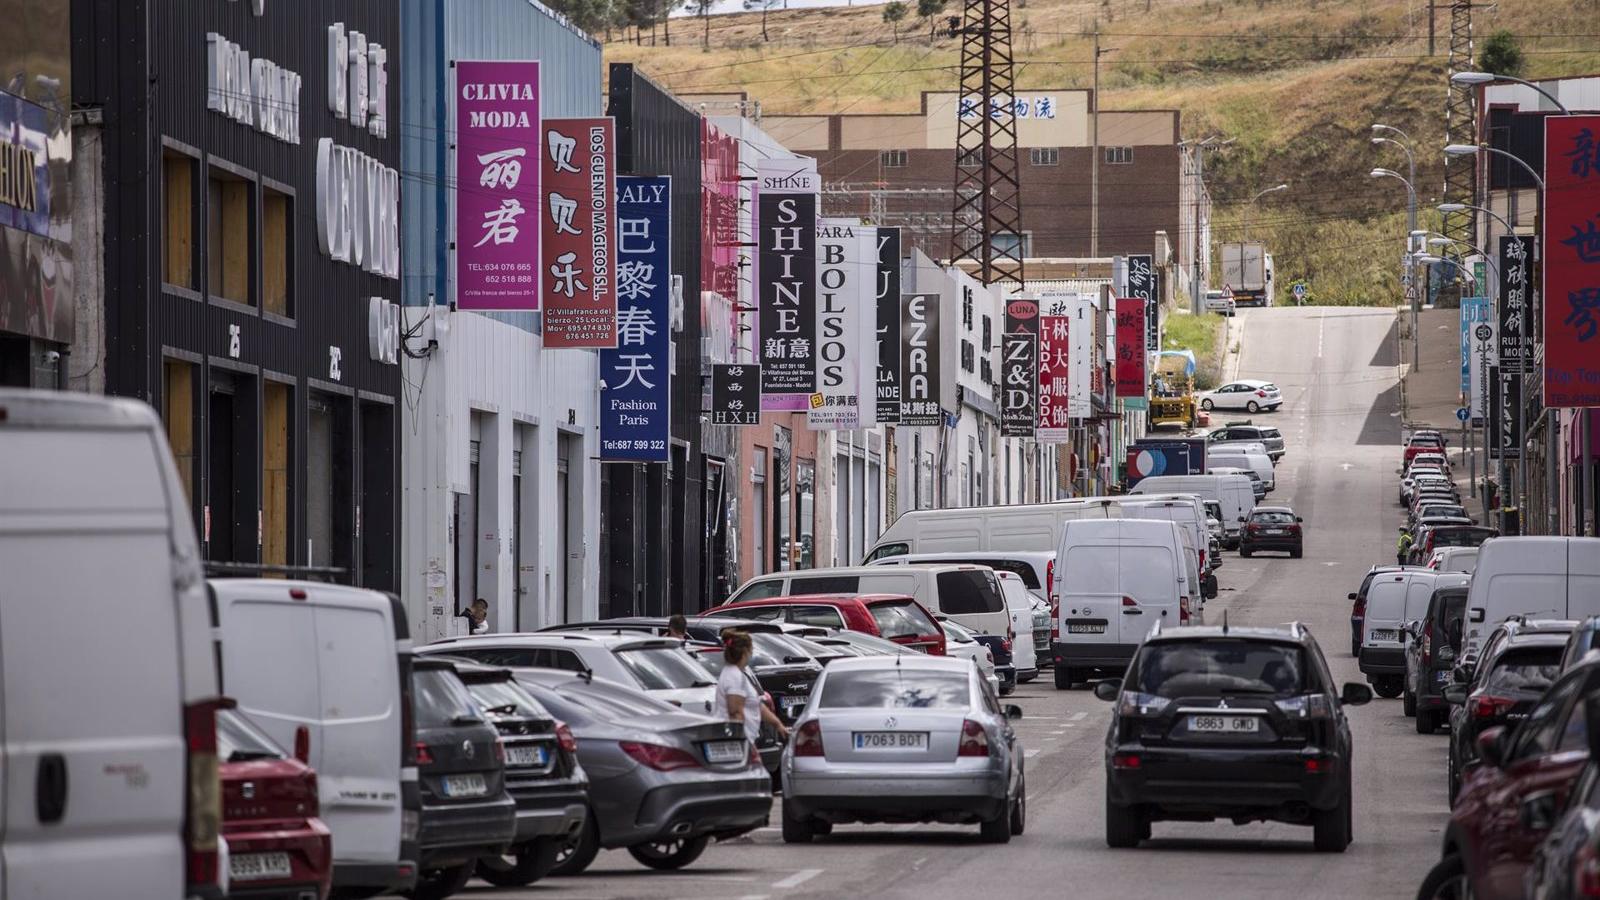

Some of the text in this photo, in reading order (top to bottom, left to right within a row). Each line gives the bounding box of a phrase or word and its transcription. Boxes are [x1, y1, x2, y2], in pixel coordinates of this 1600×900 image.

[462, 83, 535, 101] CLIVIA
[469, 111, 531, 128] MODA
[590, 127, 606, 153] LOS
[591, 154, 606, 210] CUENTO
[763, 176, 811, 189] SHINE
[473, 147, 526, 248] 丽君
[616, 185, 666, 203] ALY
[547, 129, 588, 298] 贝贝乐
[592, 211, 608, 274] MAGICOS
[501, 263, 515, 271] 076
[516, 263, 531, 271] 665
[771, 199, 804, 333] SHINE
[485, 275, 499, 283] 652
[501, 275, 515, 283] 518
[611, 217, 658, 390] 巴黎春天
[1009, 306, 1036, 314] LUNA
[821, 244, 846, 386] BOLSOS
[764, 337, 811, 359] 新意
[1004, 340, 1030, 410] Z&D
[1040, 319, 1050, 427] LINDA MODA
[1052, 319, 1068, 427] 林大服饰
[610, 399, 657, 411] Fashion
[619, 414, 649, 425] Paris
[603, 440, 665, 450] Tel:687 599 322
[1196, 718, 1254, 730] 6863 GWD
[864, 732, 923, 747] 7063 BDT
